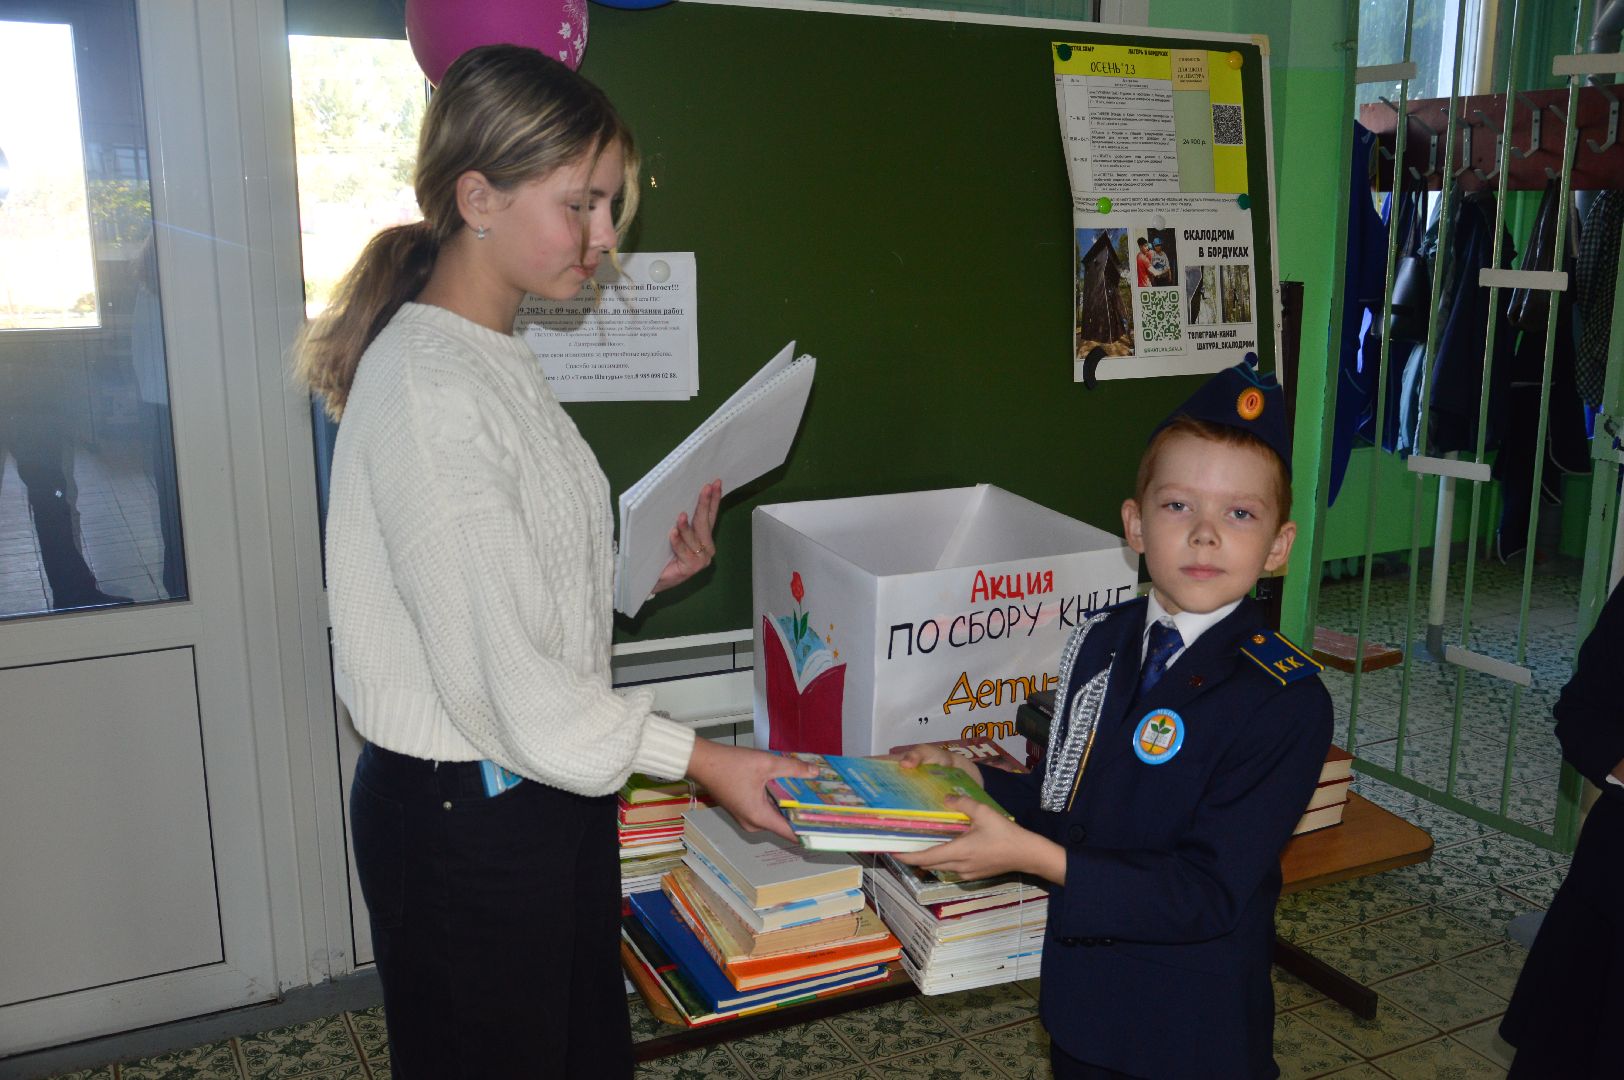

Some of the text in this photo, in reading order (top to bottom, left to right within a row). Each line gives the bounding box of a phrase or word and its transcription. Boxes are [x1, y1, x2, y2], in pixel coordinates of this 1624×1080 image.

[1183, 229, 1235, 242] СКАЛОДРОМ
[1198, 246, 1249, 259] В БОРДУКАХ
[646, 283, 680, 291] Погост!!!
[517, 307, 546, 316] 9.2023г
[887, 619, 940, 659] ПО
[948, 602, 1043, 648] СБОРУ
[1273, 656, 1304, 674] КК
